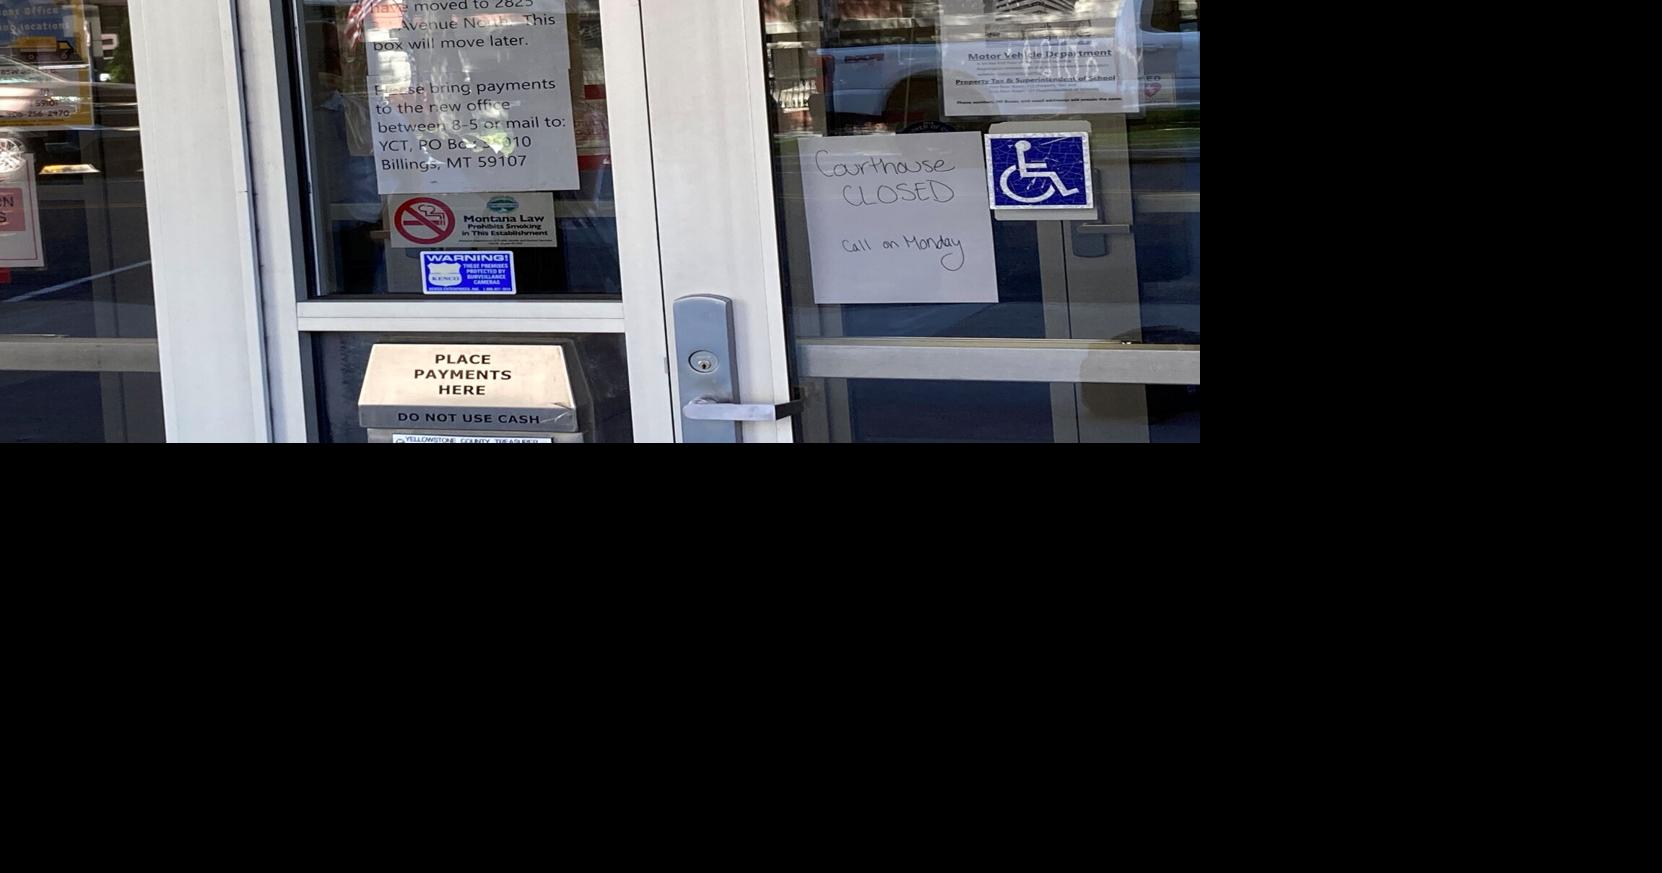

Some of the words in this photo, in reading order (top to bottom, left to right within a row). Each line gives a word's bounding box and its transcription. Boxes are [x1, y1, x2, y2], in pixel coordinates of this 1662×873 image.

[370, 0, 408, 13] have
[414, 0, 468, 11] moved
[474, 0, 489, 9] to
[401, 18, 458, 31] Avenue
[523, 13, 556, 26] This
[373, 37, 402, 51] box
[408, 37, 435, 50] will
[440, 38, 485, 49] move
[490, 34, 529, 47] later.
[968, 52, 1001, 61] Motor
[374, 84, 425, 96] Pease
[430, 82, 470, 95] bring
[476, 79, 556, 96] payments
[375, 103, 392, 115] to
[397, 101, 423, 113] the
[429, 101, 461, 113] new
[466, 98, 511, 112] office
[377, 120, 446, 134] between
[451, 118, 479, 131] 8-5
[482, 119, 505, 129] or
[505, 116, 540, 129] mail
[544, 115, 566, 128] to:
[379, 139, 412, 153] YCT,
[418, 137, 442, 151] PO
[481, 135, 532, 149] 3010
[381, 156, 441, 173] Billings,
[446, 156, 472, 169] MT
[478, 154, 527, 169] 59107
[815, 149, 956, 177] Courthouse
[843, 179, 955, 206] CLOSED
[463, 214, 517, 223] Montana
[519, 214, 545, 222] Law
[505, 223, 542, 231] Smoking
[426, 254, 509, 262] WARNING!
[882, 239, 899, 249] on
[903, 235, 965, 271] Monday
[435, 354, 491, 365] PLACE
[414, 369, 512, 381] PAYMENTS
[438, 385, 486, 396] HERE
[397, 412, 420, 422] DO
[425, 413, 457, 423] NOT
[462, 413, 493, 424] USE
[498, 414, 541, 425] CASH
